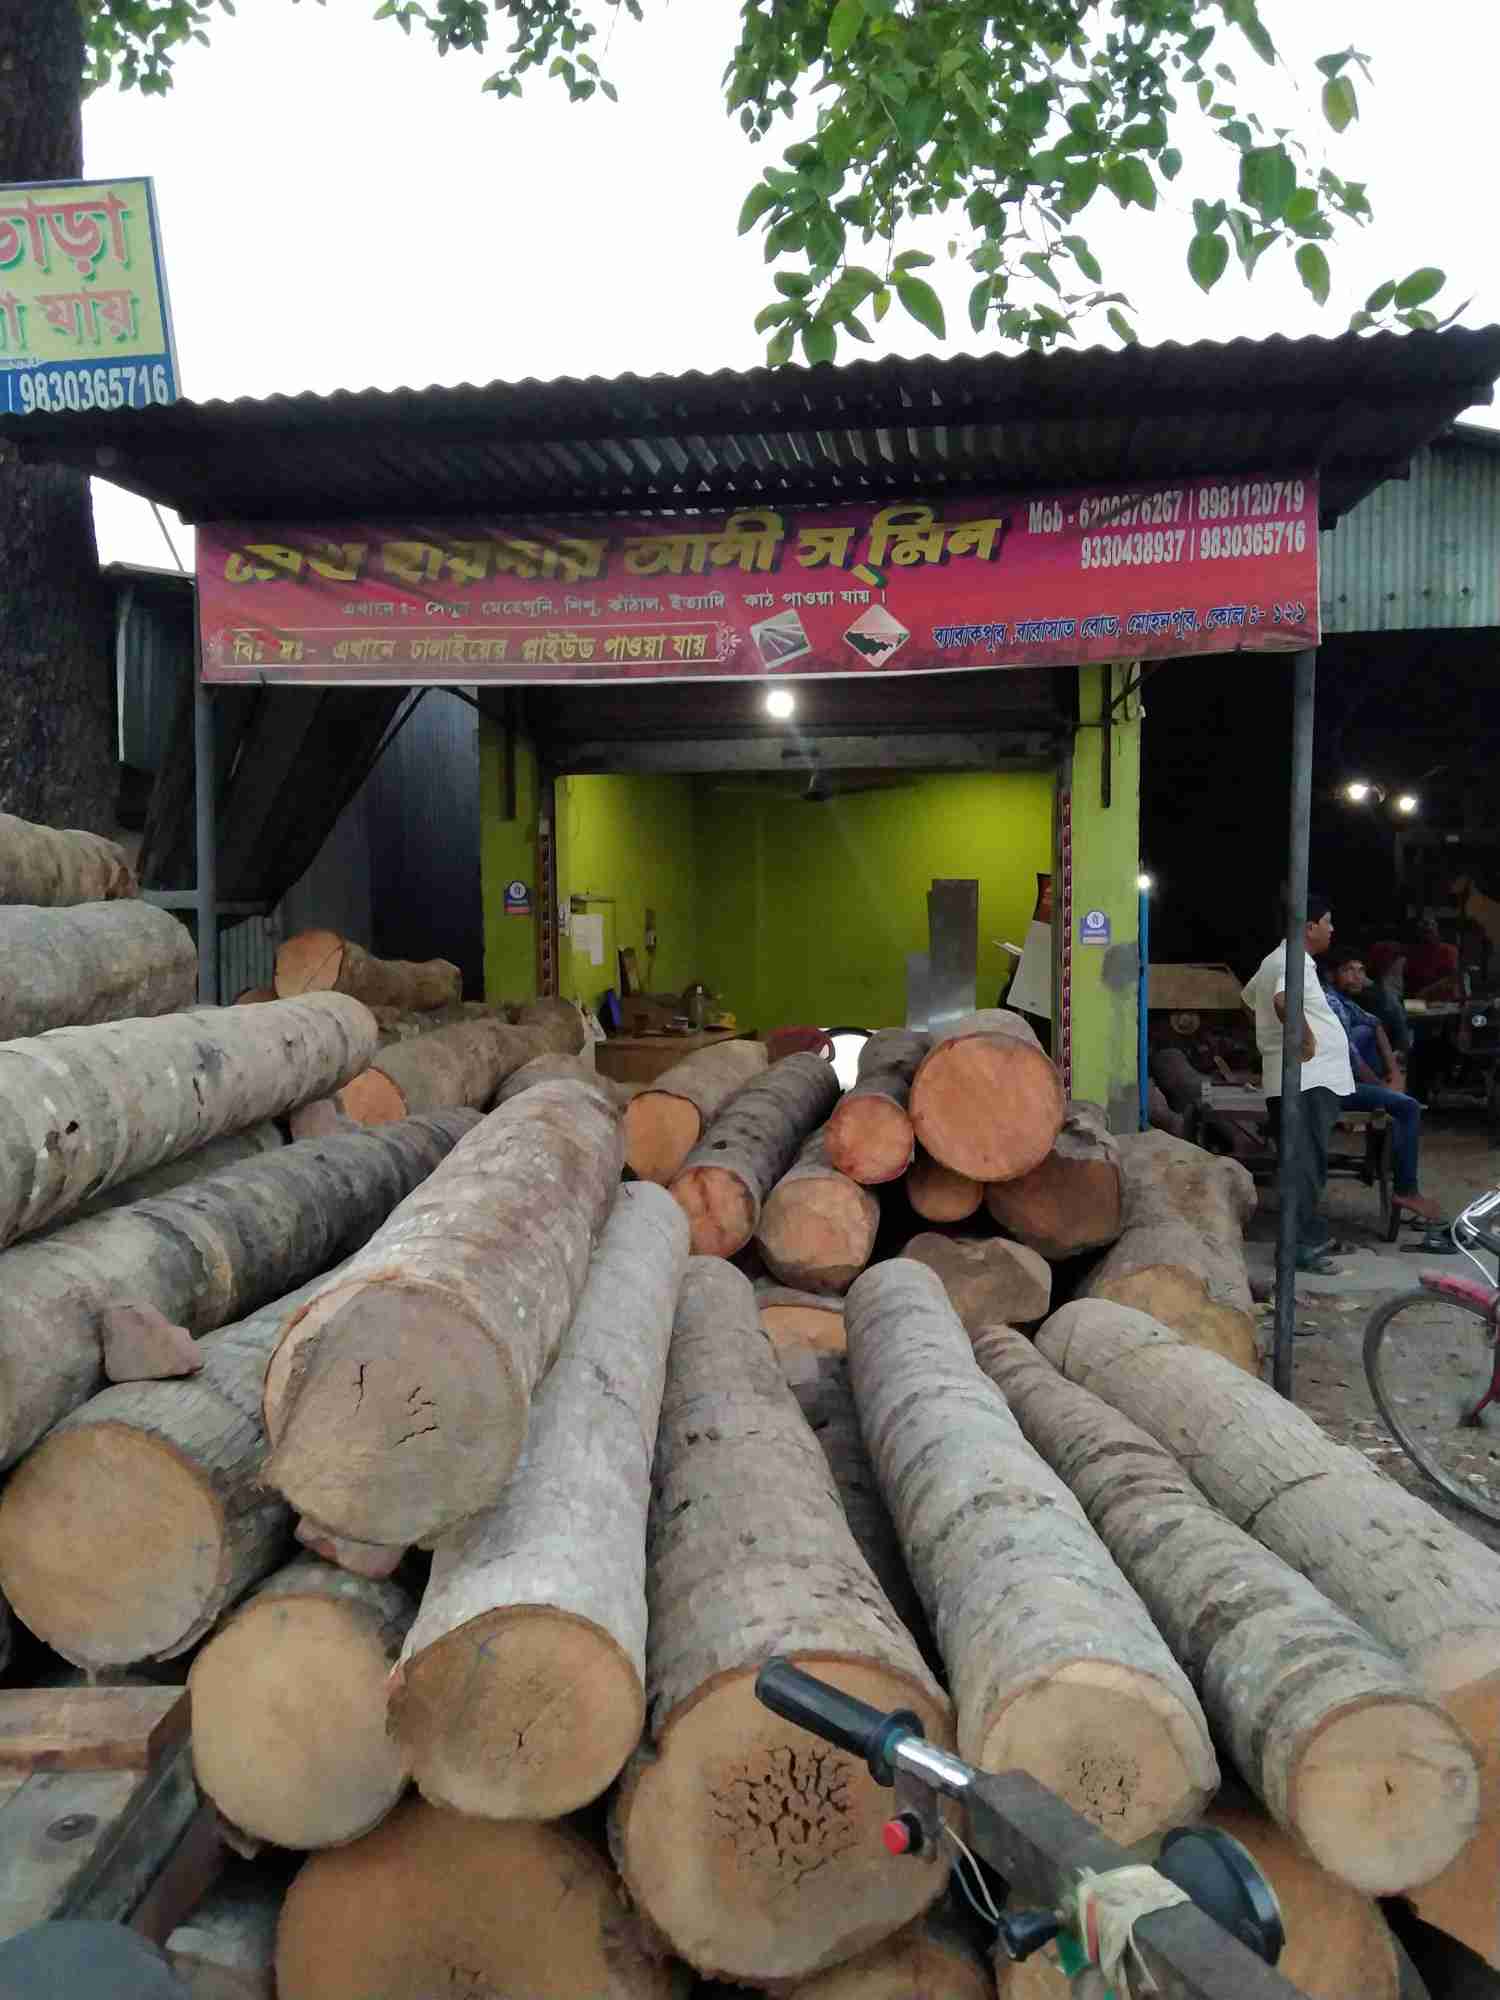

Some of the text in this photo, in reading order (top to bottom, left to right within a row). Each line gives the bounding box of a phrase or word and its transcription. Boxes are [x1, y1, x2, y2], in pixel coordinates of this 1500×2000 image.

[34, 288, 134, 338] যায়
[20, 364, 169, 413] 9830365716
[1028, 501, 1063, 534] Mob
[1199, 480, 1305, 520] 8981120719
[623, 511, 784, 575] আলী
[866, 505, 1002, 568] মিল
[1080, 530, 1186, 569] 9330438937
[1200, 520, 1306, 560] 9830365716
[744, 588, 774, 607] কাঠ
[782, 590, 834, 608] পাওয়া
[841, 590, 870, 606] যায়
[604, 634, 666, 661] পাওয়া
[671, 634, 708, 658] যায়
